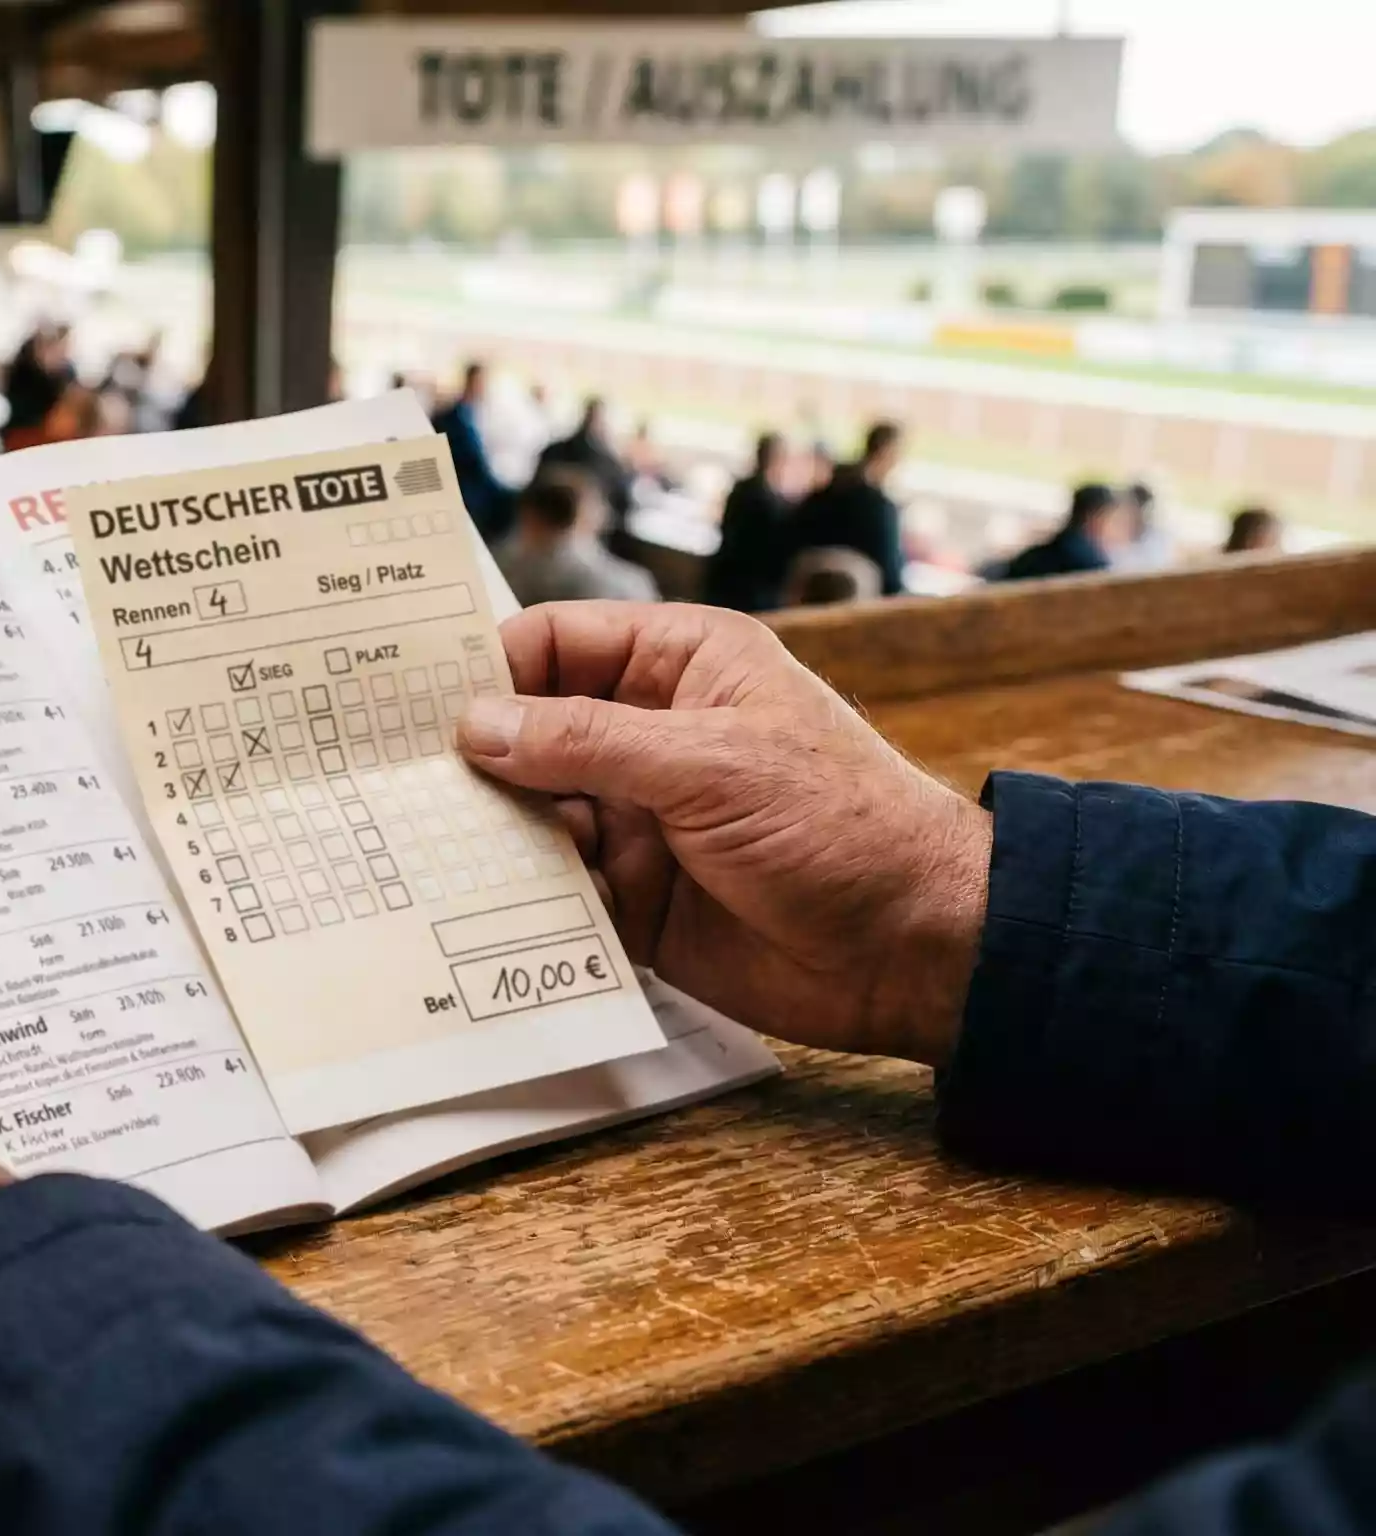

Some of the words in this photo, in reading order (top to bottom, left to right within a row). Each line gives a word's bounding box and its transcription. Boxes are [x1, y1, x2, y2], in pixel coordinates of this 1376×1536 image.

[413, 50, 564, 128] TOTE
[624, 50, 1030, 126] AUSZAHLUNG
[90, 484, 293, 539] DEUTSCHER
[301, 471, 382, 505] TOTE
[100, 535, 282, 583] Wettschein
[318, 571, 361, 595] Sieg
[365, 567, 372, 586] /
[377, 561, 425, 584] Platz
[210, 588, 227, 615] 4
[113, 599, 191, 627] Rennen
[135, 639, 152, 667] 4
[356, 645, 400, 665] PLATZ
[259, 664, 294, 681] SIEG
[148, 721, 157, 735] 1
[155, 753, 167, 767] 2
[78, 775, 101, 790] 4-1
[165, 784, 176, 799] 3
[176, 812, 188, 826] 4
[113, 846, 136, 861] 4-1
[188, 840, 200, 855] 5
[200, 868, 212, 884] 6
[211, 898, 223, 913] 7
[146, 909, 169, 925] 6-1
[225, 927, 237, 943] 8
[491, 960, 575, 1004] 10,00
[584, 954, 607, 980] €
[185, 982, 207, 998] 6-1
[424, 994, 457, 1015] Bet
[225, 1058, 247, 1074] 4-1
[14, 1100, 74, 1129] Fischer
